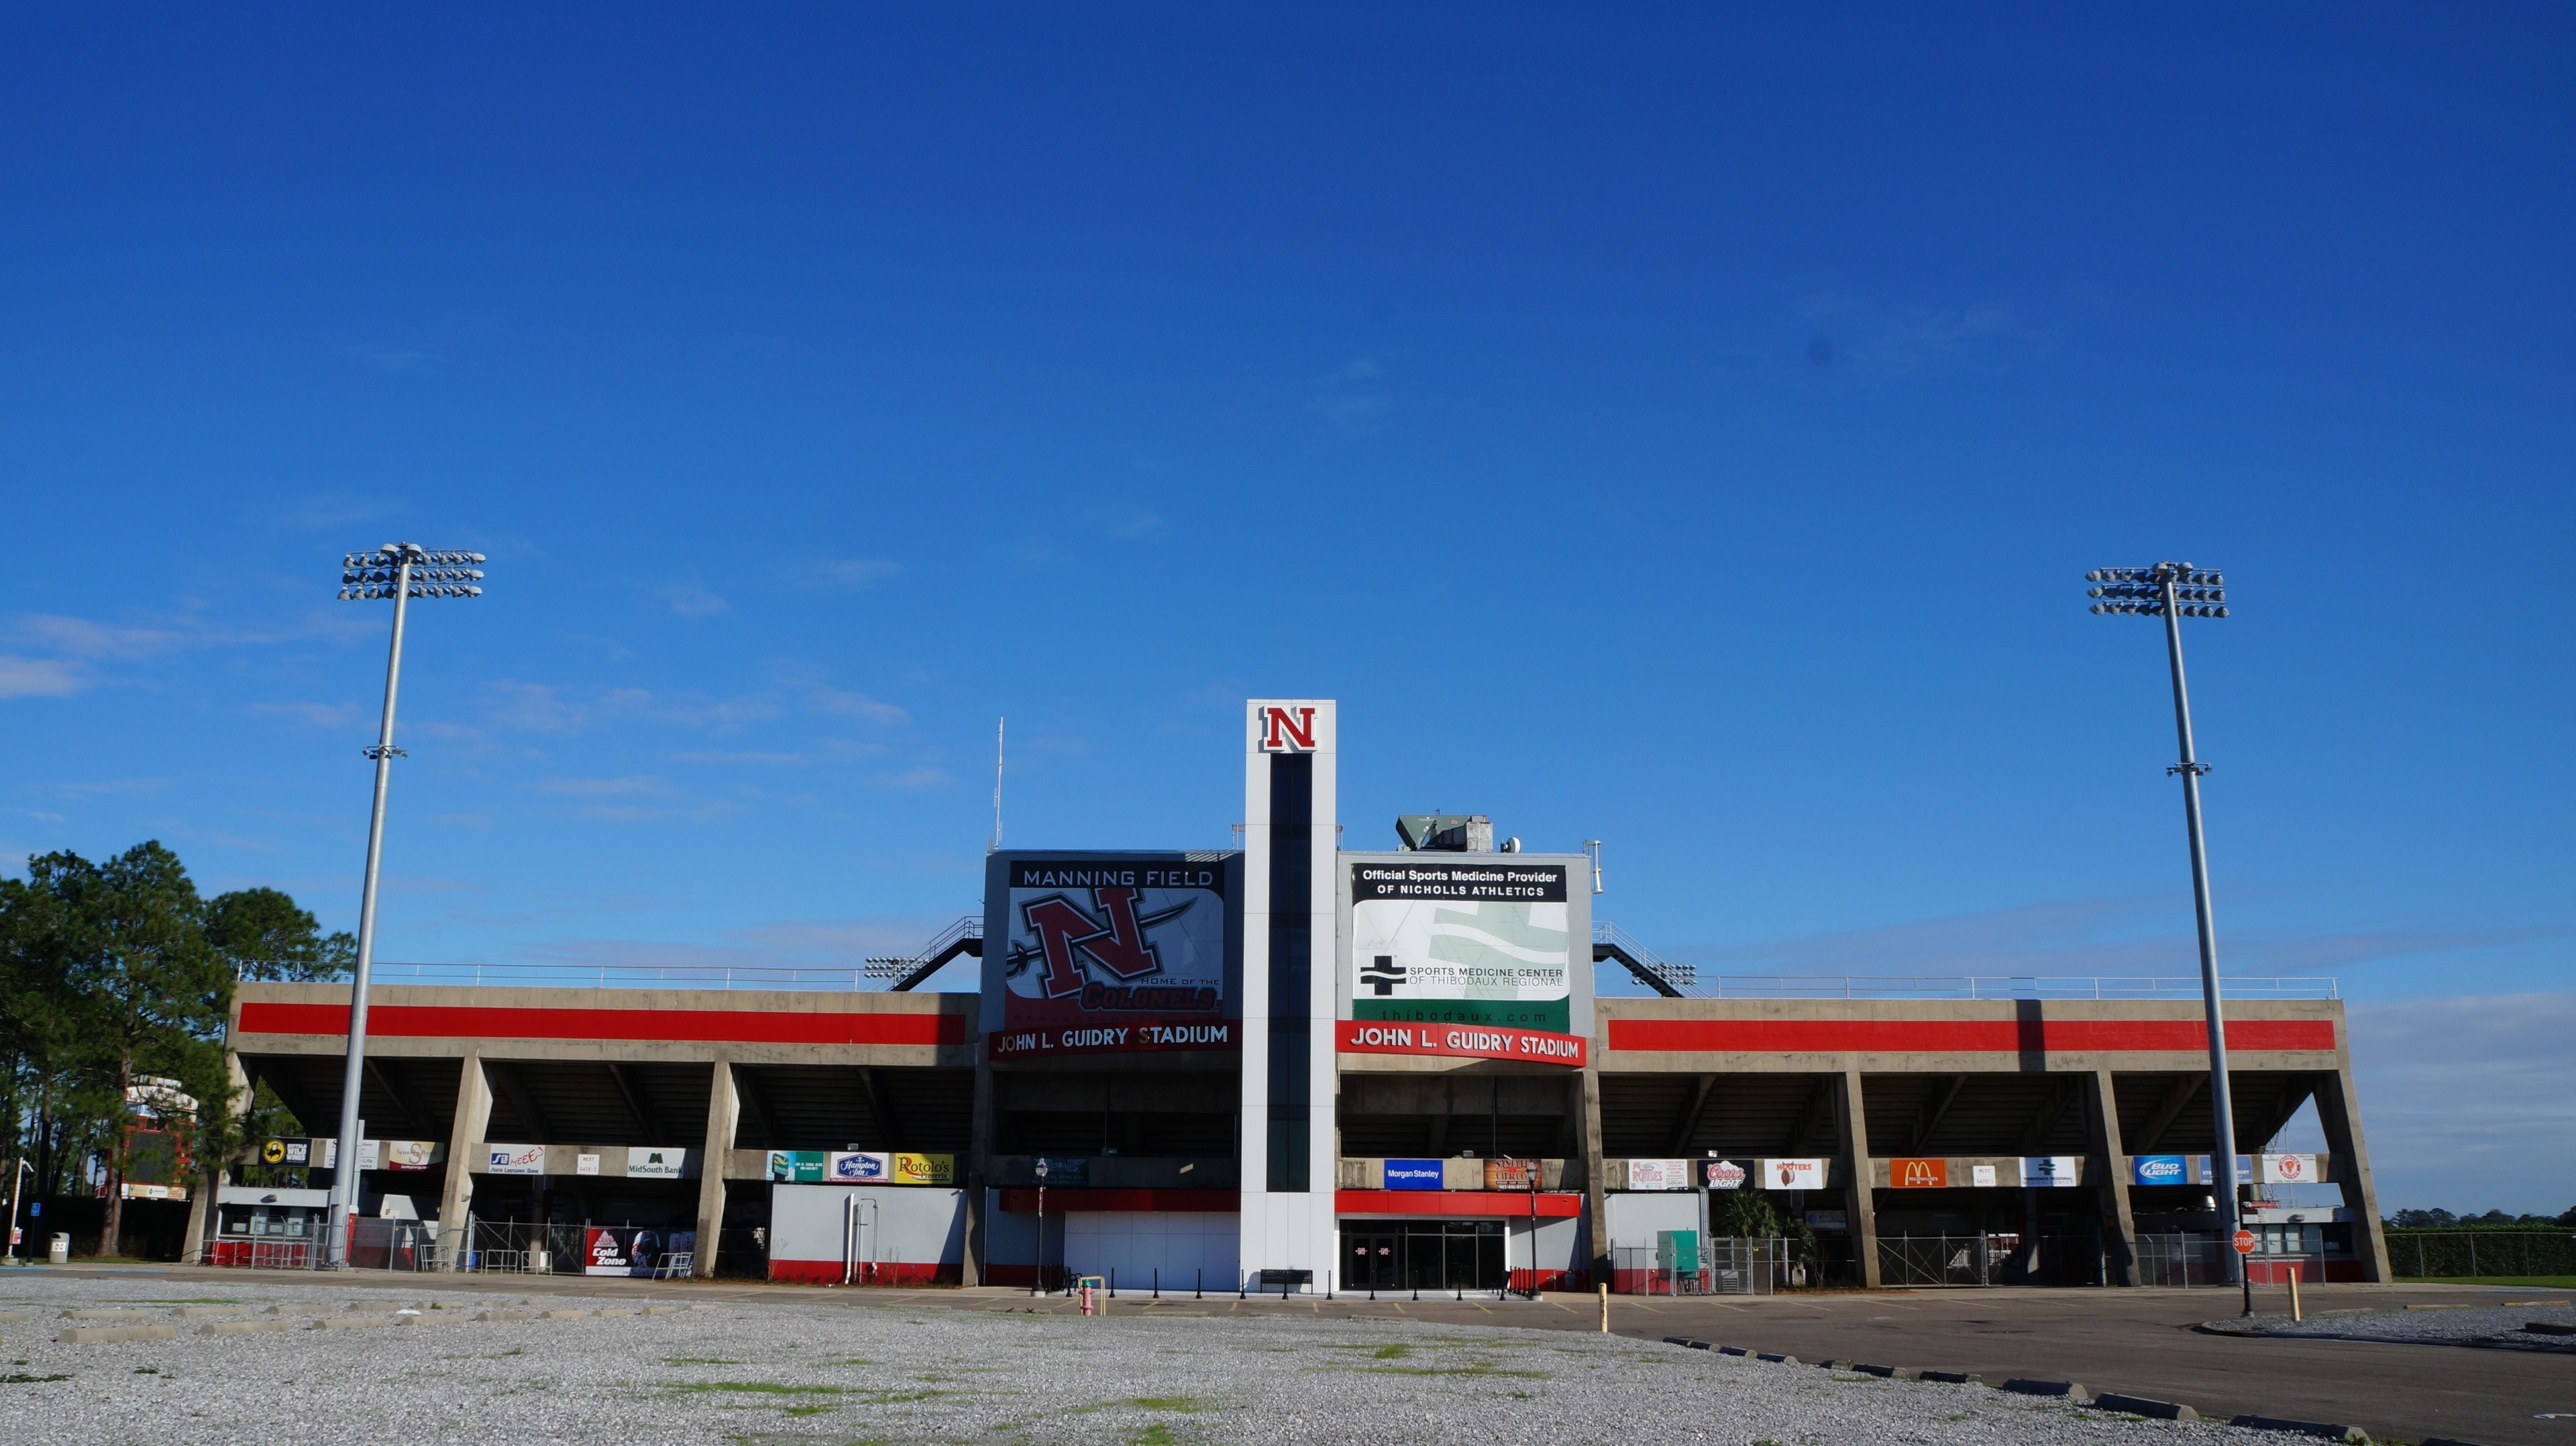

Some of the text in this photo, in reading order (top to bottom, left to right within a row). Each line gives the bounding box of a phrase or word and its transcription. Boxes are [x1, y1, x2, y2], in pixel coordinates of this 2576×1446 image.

[1265, 706, 1316, 748] N
[1024, 871, 1213, 886] MANNING FIELD
[1363, 870, 1557, 883] Official Sports Medicine Provider
[1377, 885, 1544, 897] OF NICHOLLS ATHLETICS
[1410, 967, 1563, 977] SPORTS MEDICINE CENTER
[1409, 977, 1563, 987] OF THIBODAUX REGIONAL
[1080, 983, 1218, 1011] COLONELS
[1382, 1010, 1546, 1022] thibodaux.com
[998, 1025, 1228, 1053] JOHN L. GUIDRY STADIUM
[1351, 1027, 1578, 1058] JOHN L. GUIDRY STADIUM
[628, 1165, 683, 1174] MidSouth Bank
[841, 1160, 879, 1172] Hampton
[898, 1156, 949, 1172] Rotolo's
[1776, 1163, 1812, 1171] HOOTERS
[849, 1168, 868, 1177] Inn
[1388, 1170, 1439, 1179] Morgan Stanley
[1708, 1164, 1744, 1180] Coors
[1709, 1179, 1742, 1188] LIGHT
[2234, 1237, 2253, 1247] STOP
[592, 1248, 619, 1257] Cold
[596, 1257, 627, 1266] Zone
